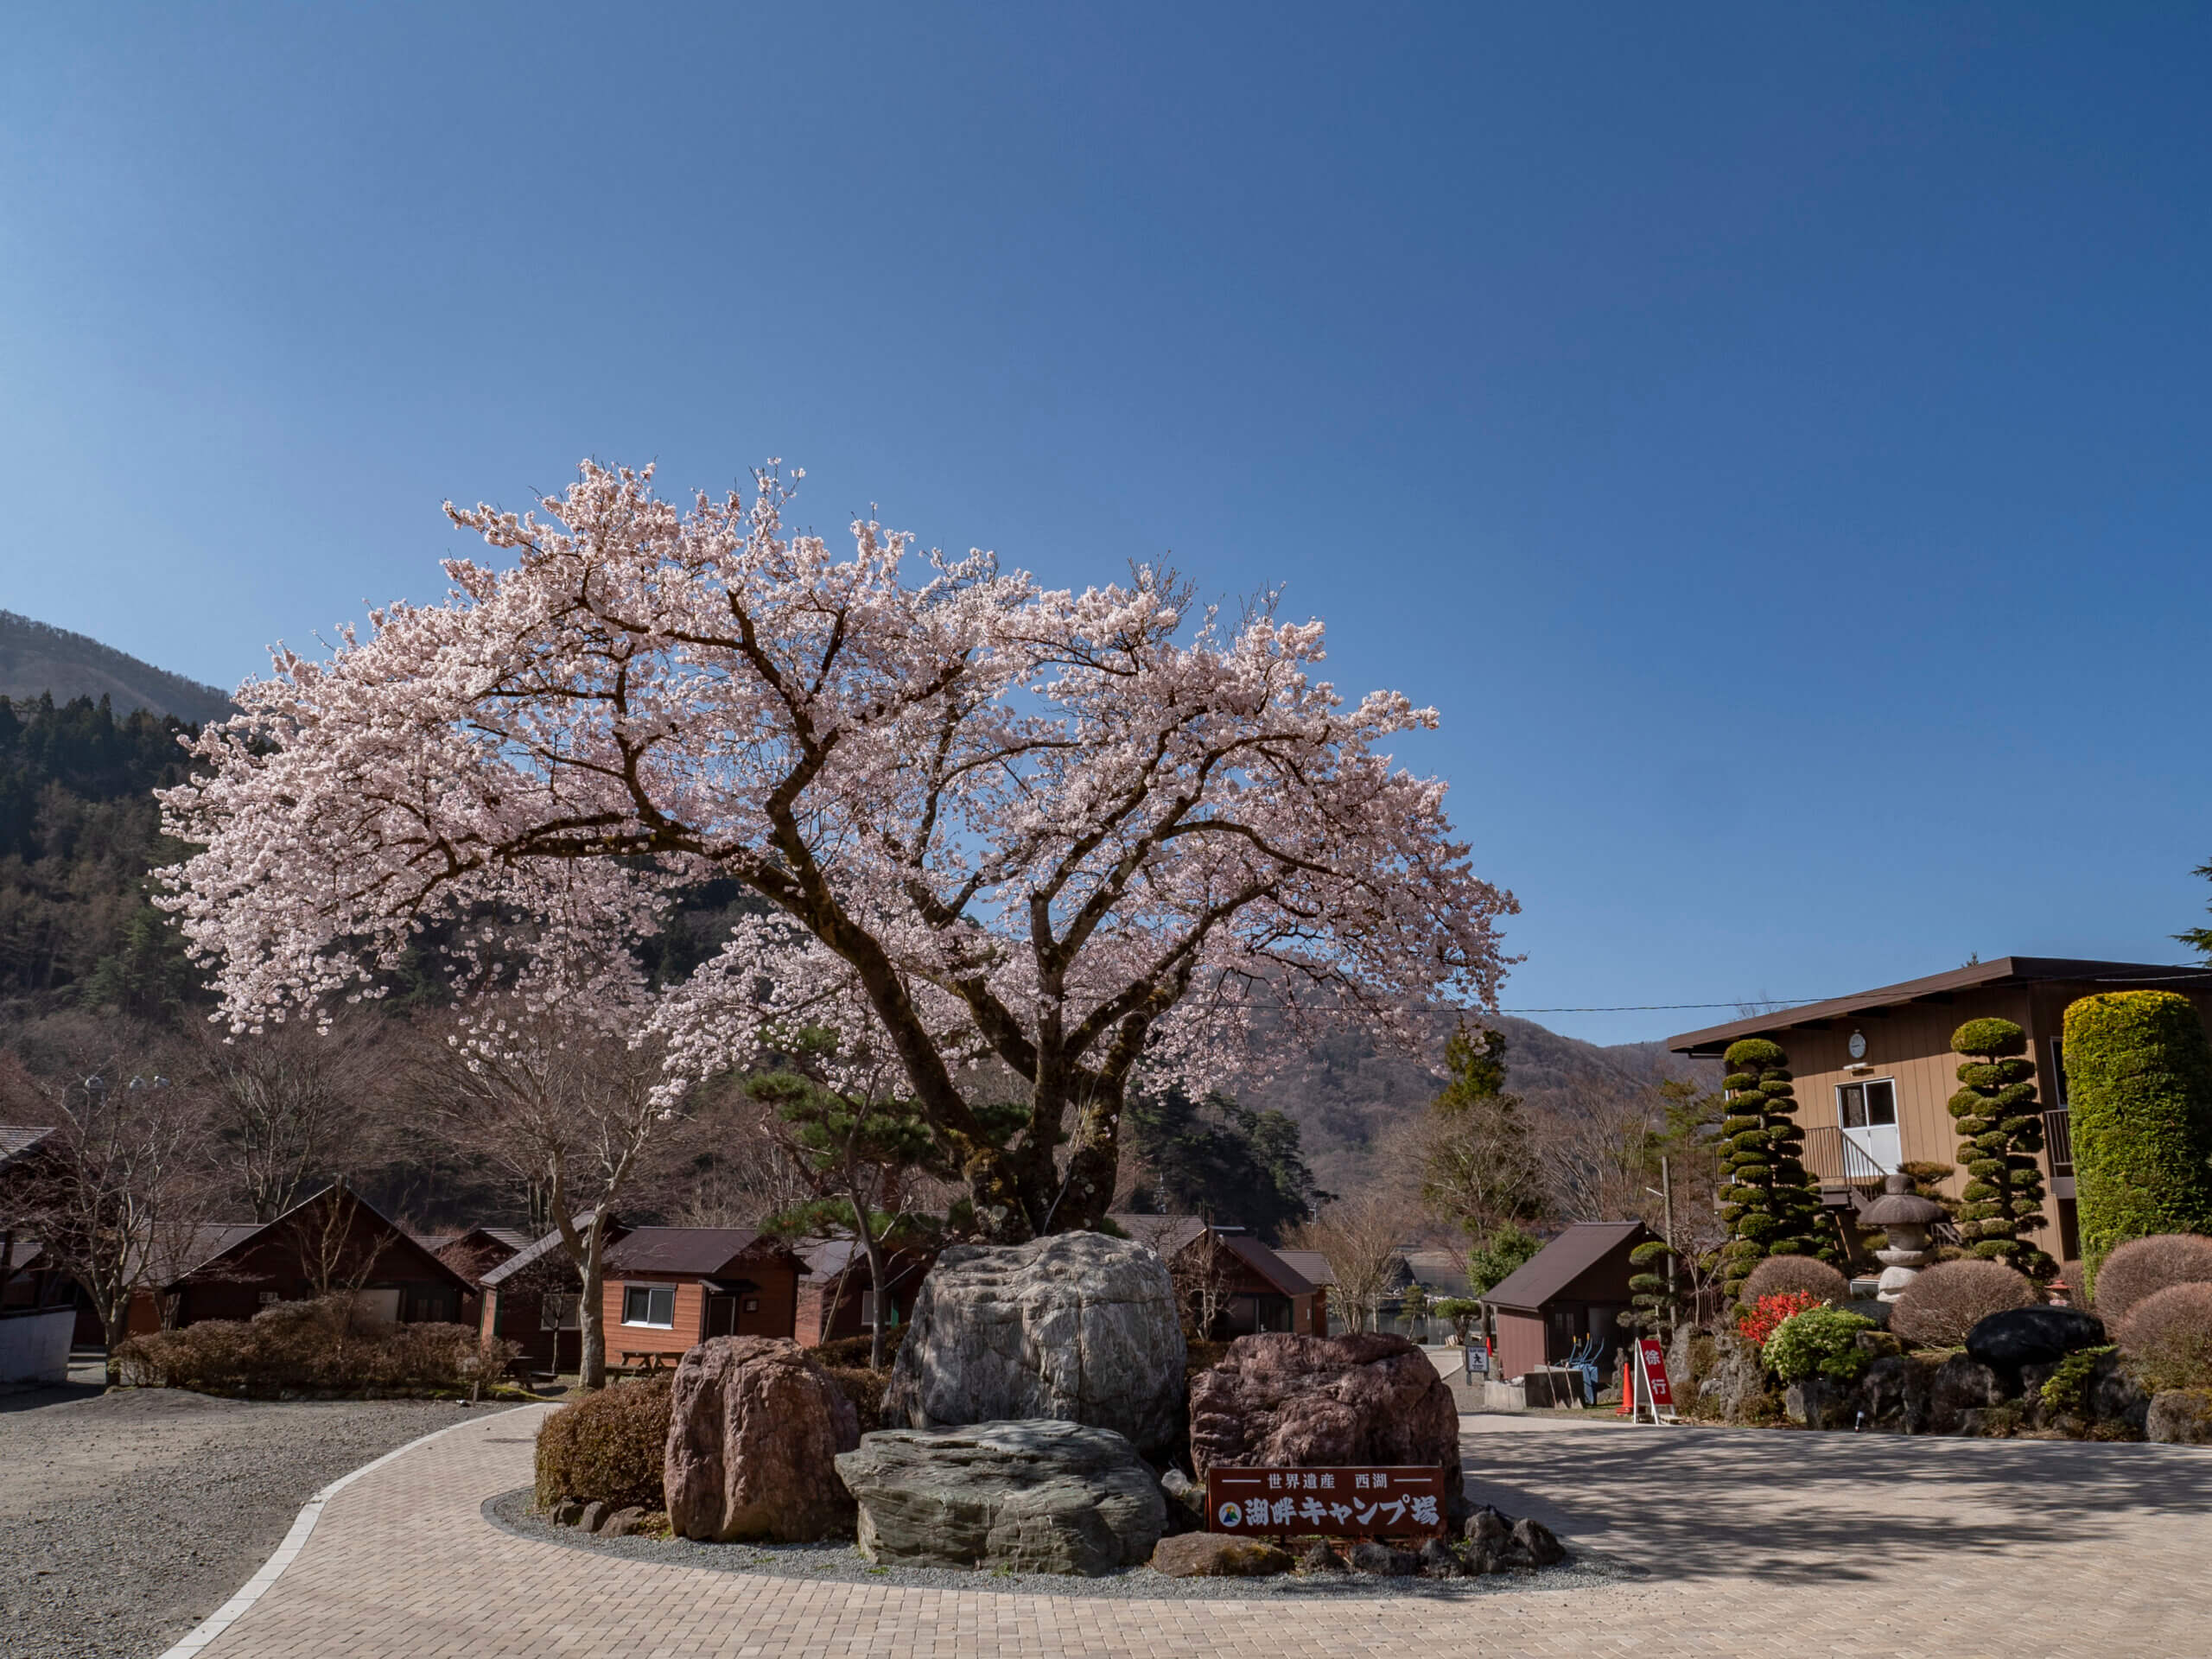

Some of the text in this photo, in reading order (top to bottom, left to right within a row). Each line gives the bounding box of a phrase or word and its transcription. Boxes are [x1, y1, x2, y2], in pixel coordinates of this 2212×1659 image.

[1644, 1350, 1667, 1395] 徐行
[1268, 1472, 1388, 1489] 世界遺産 西湖
[1244, 1494, 1440, 1526] 湖畔キャンプ場
